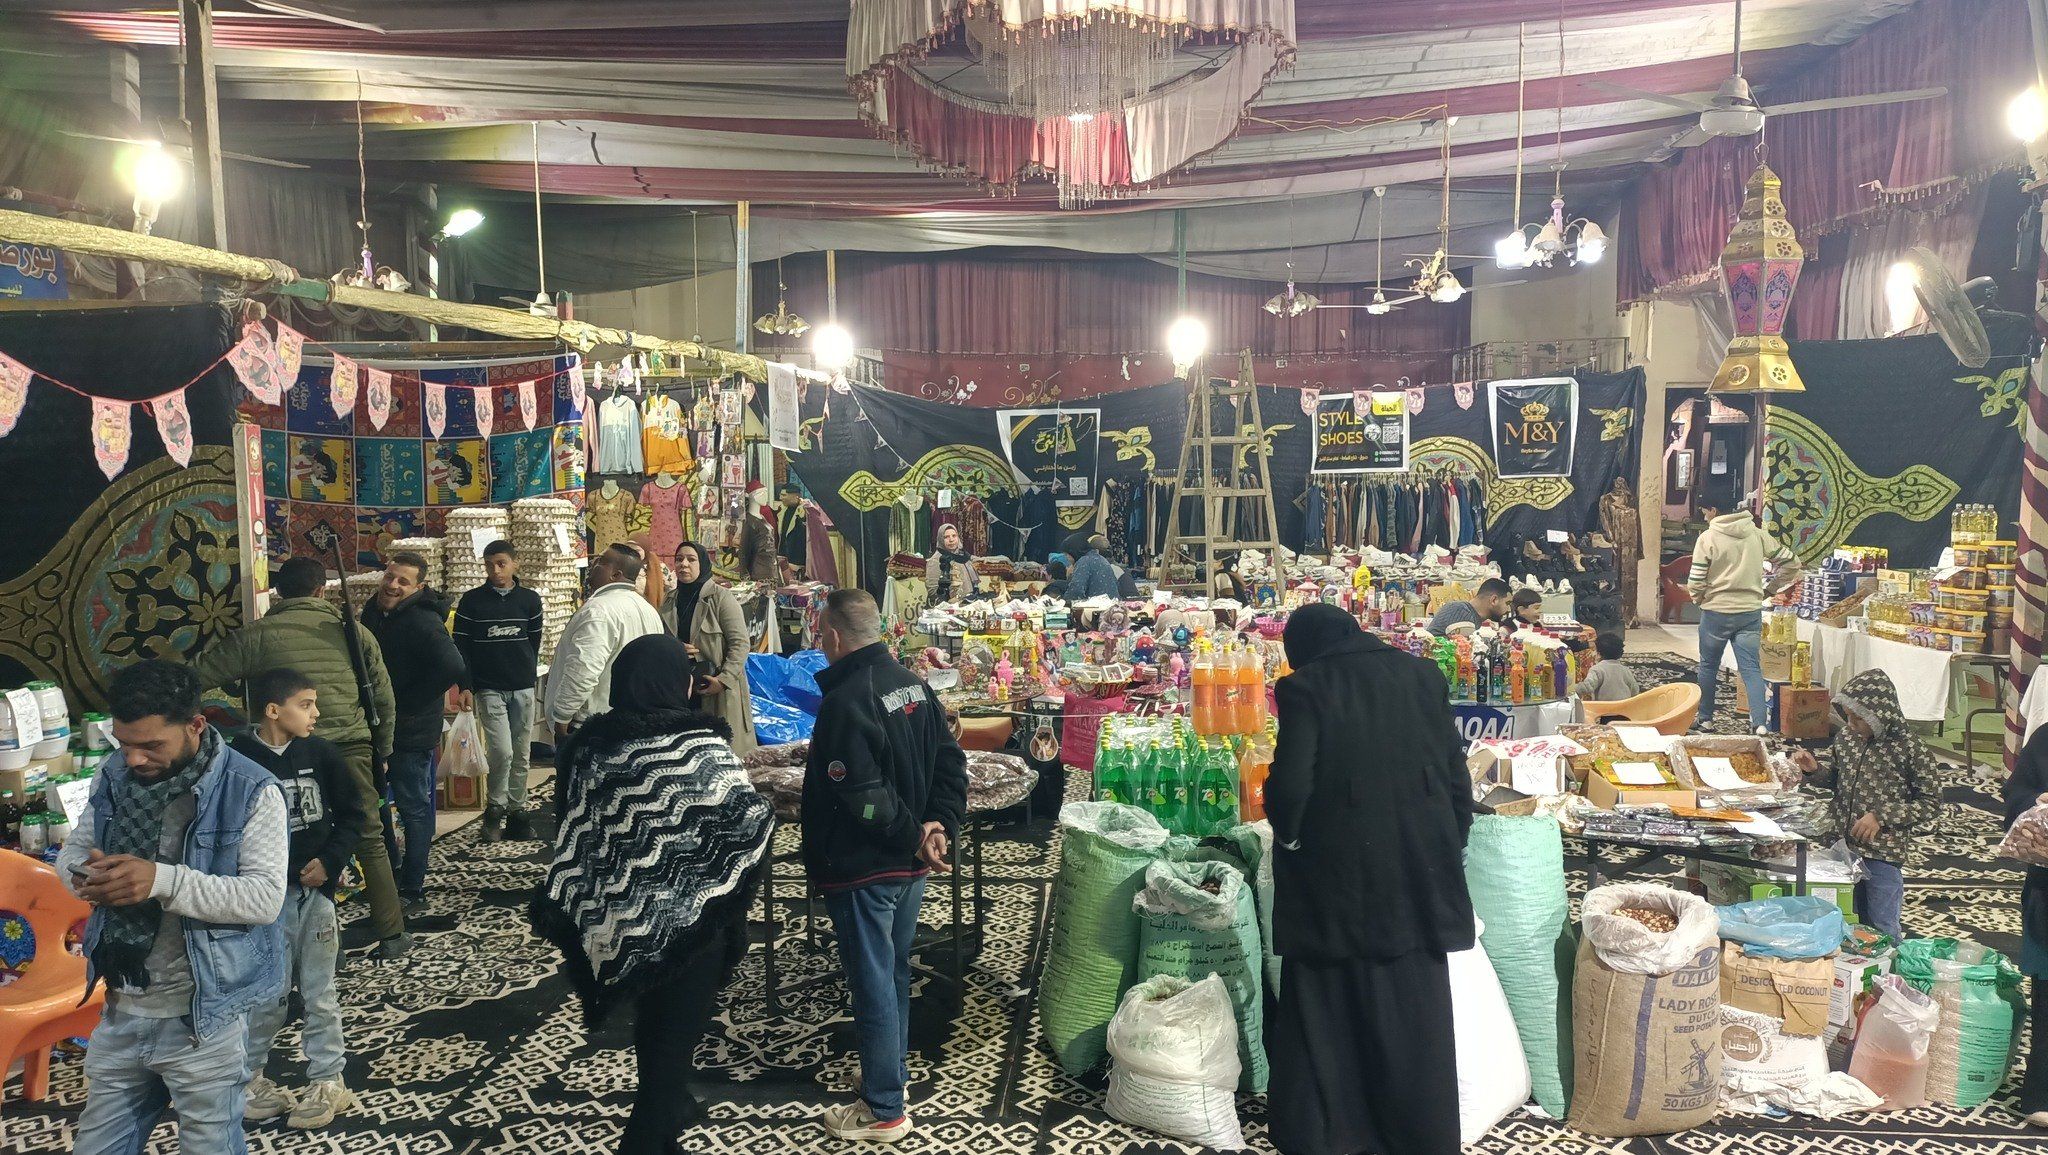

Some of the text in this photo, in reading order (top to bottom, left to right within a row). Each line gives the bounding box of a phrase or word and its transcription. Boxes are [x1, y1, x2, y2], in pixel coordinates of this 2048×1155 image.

[0, 244, 57, 284] بورص
[1319, 411, 1363, 427] STYLE
[1320, 431, 1363, 446] SHOES
[1504, 421, 1565, 445] M&Y
[1795, 985, 1828, 997] COCONUT
[1658, 997, 1697, 1011] LADY
[1673, 1025, 1695, 1034] SEED
[1663, 1097, 1679, 1108] 50
